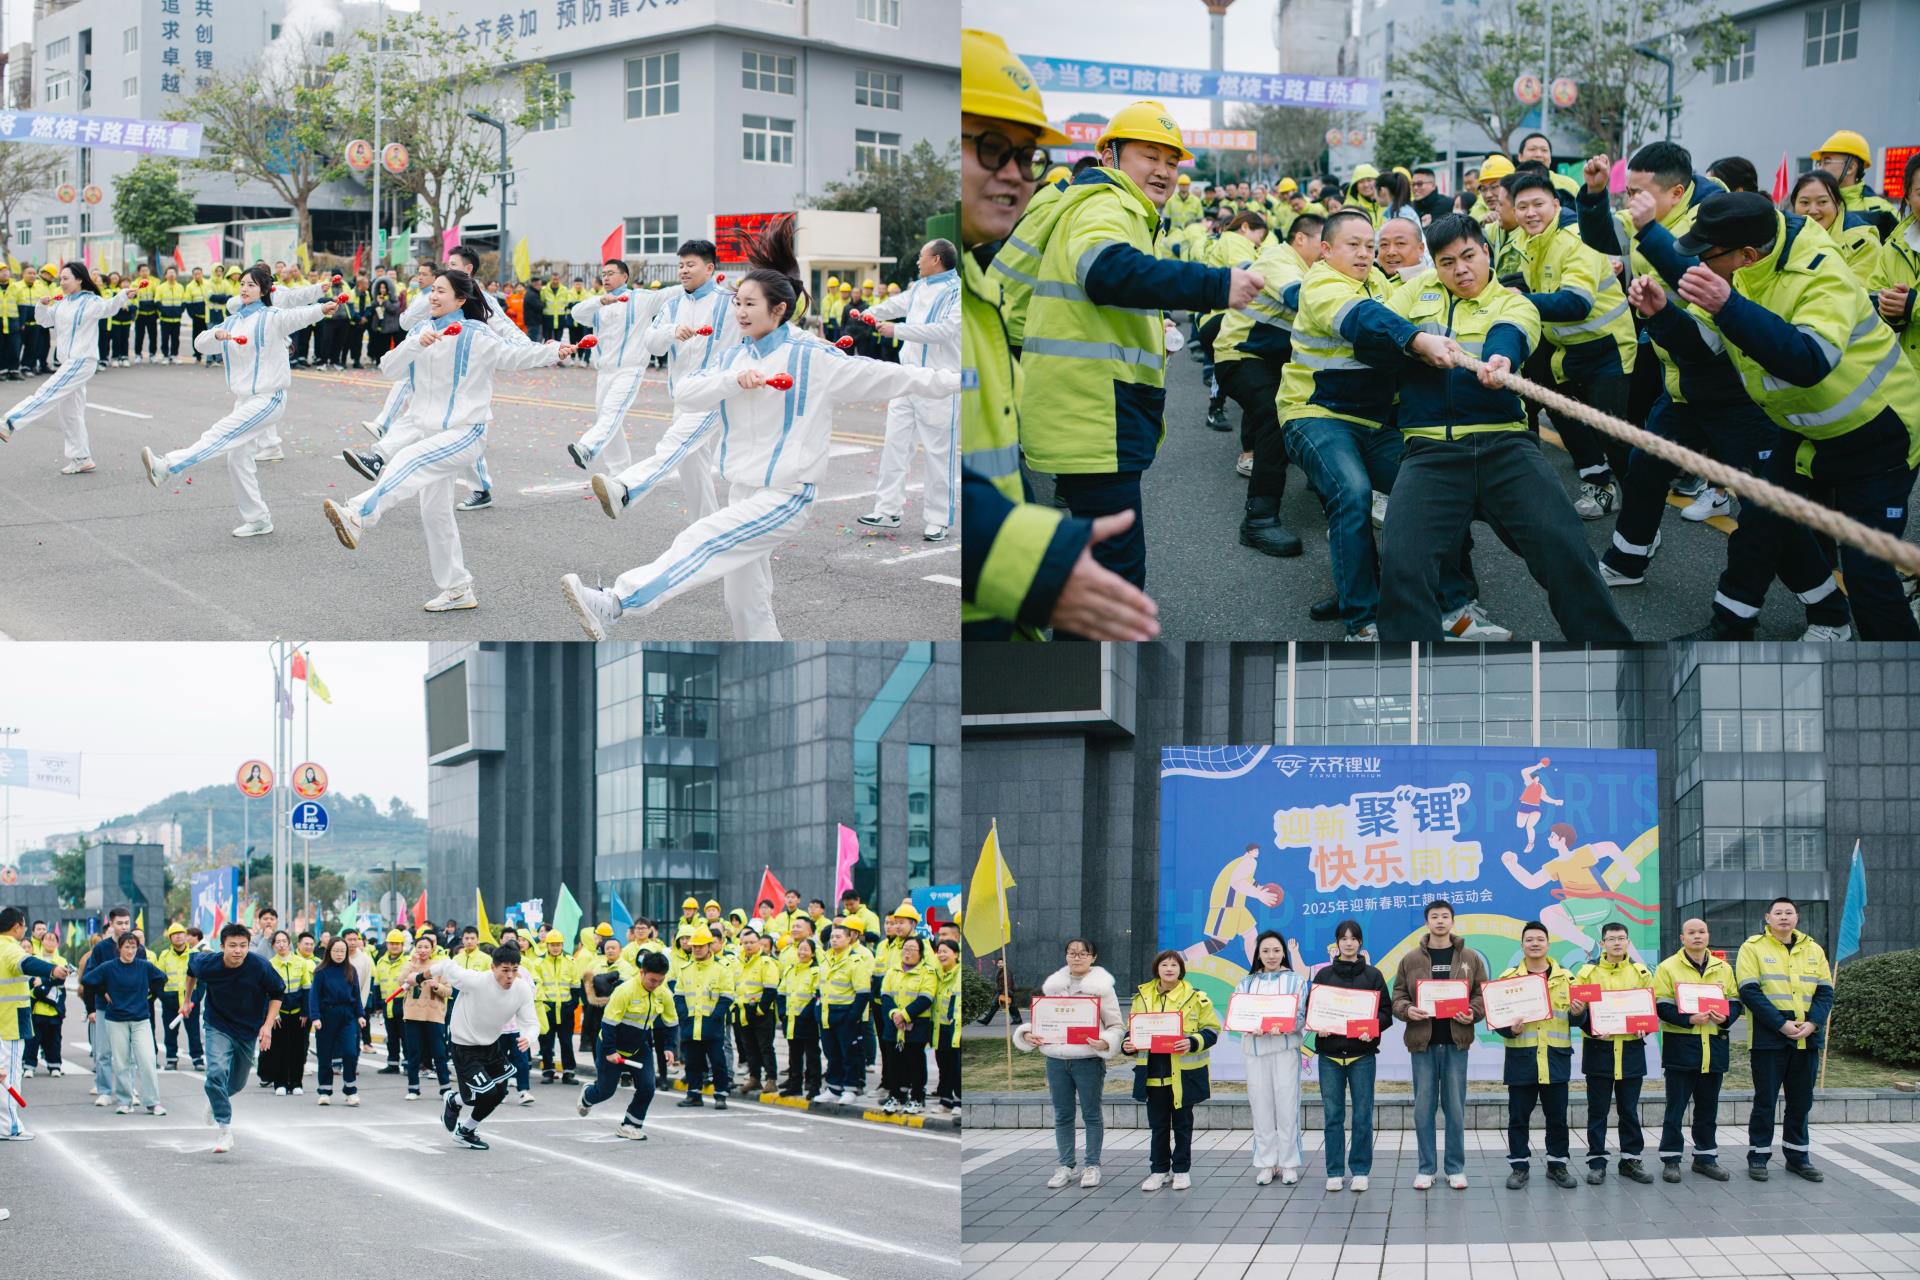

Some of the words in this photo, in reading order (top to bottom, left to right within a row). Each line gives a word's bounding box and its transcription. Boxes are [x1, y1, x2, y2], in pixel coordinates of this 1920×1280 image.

[1217, 75, 1368, 105] 燃烧卡路里热量
[30, 115, 189, 151] 燃烧卡路里热量
[1309, 757, 1381, 773] 天齐锂业
[1314, 841, 1480, 889] 快乐同行
[1302, 888, 1493, 915] 2025年迎新春职工趣味运动会
